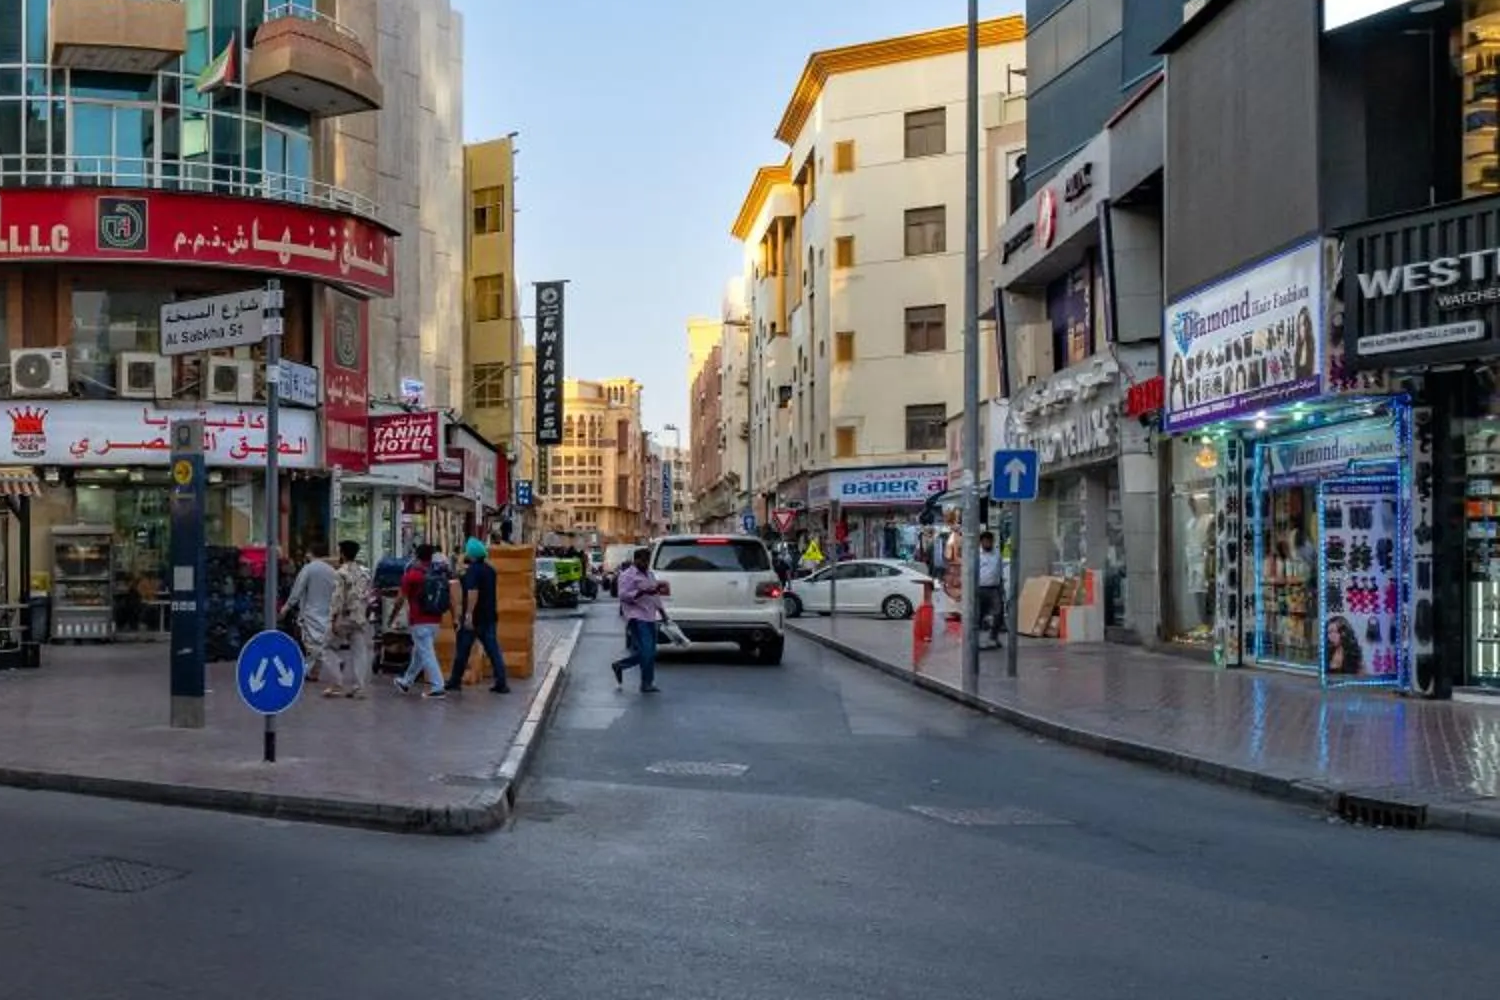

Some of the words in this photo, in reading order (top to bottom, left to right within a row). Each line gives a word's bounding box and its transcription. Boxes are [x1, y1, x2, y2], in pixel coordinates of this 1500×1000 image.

[339, 228, 389, 275] فندق
[1357, 247, 1500, 299] WEST
[164, 303, 215, 324] السبخة
[221, 297, 259, 320] شارع
[1183, 291, 1250, 341] Diamond
[181, 327, 225, 344] Sabkha
[229, 324, 244, 336] St
[541, 316, 557, 428] EMIRATES
[374, 424, 433, 440] TANHA
[373, 438, 434, 452] HOTEL
